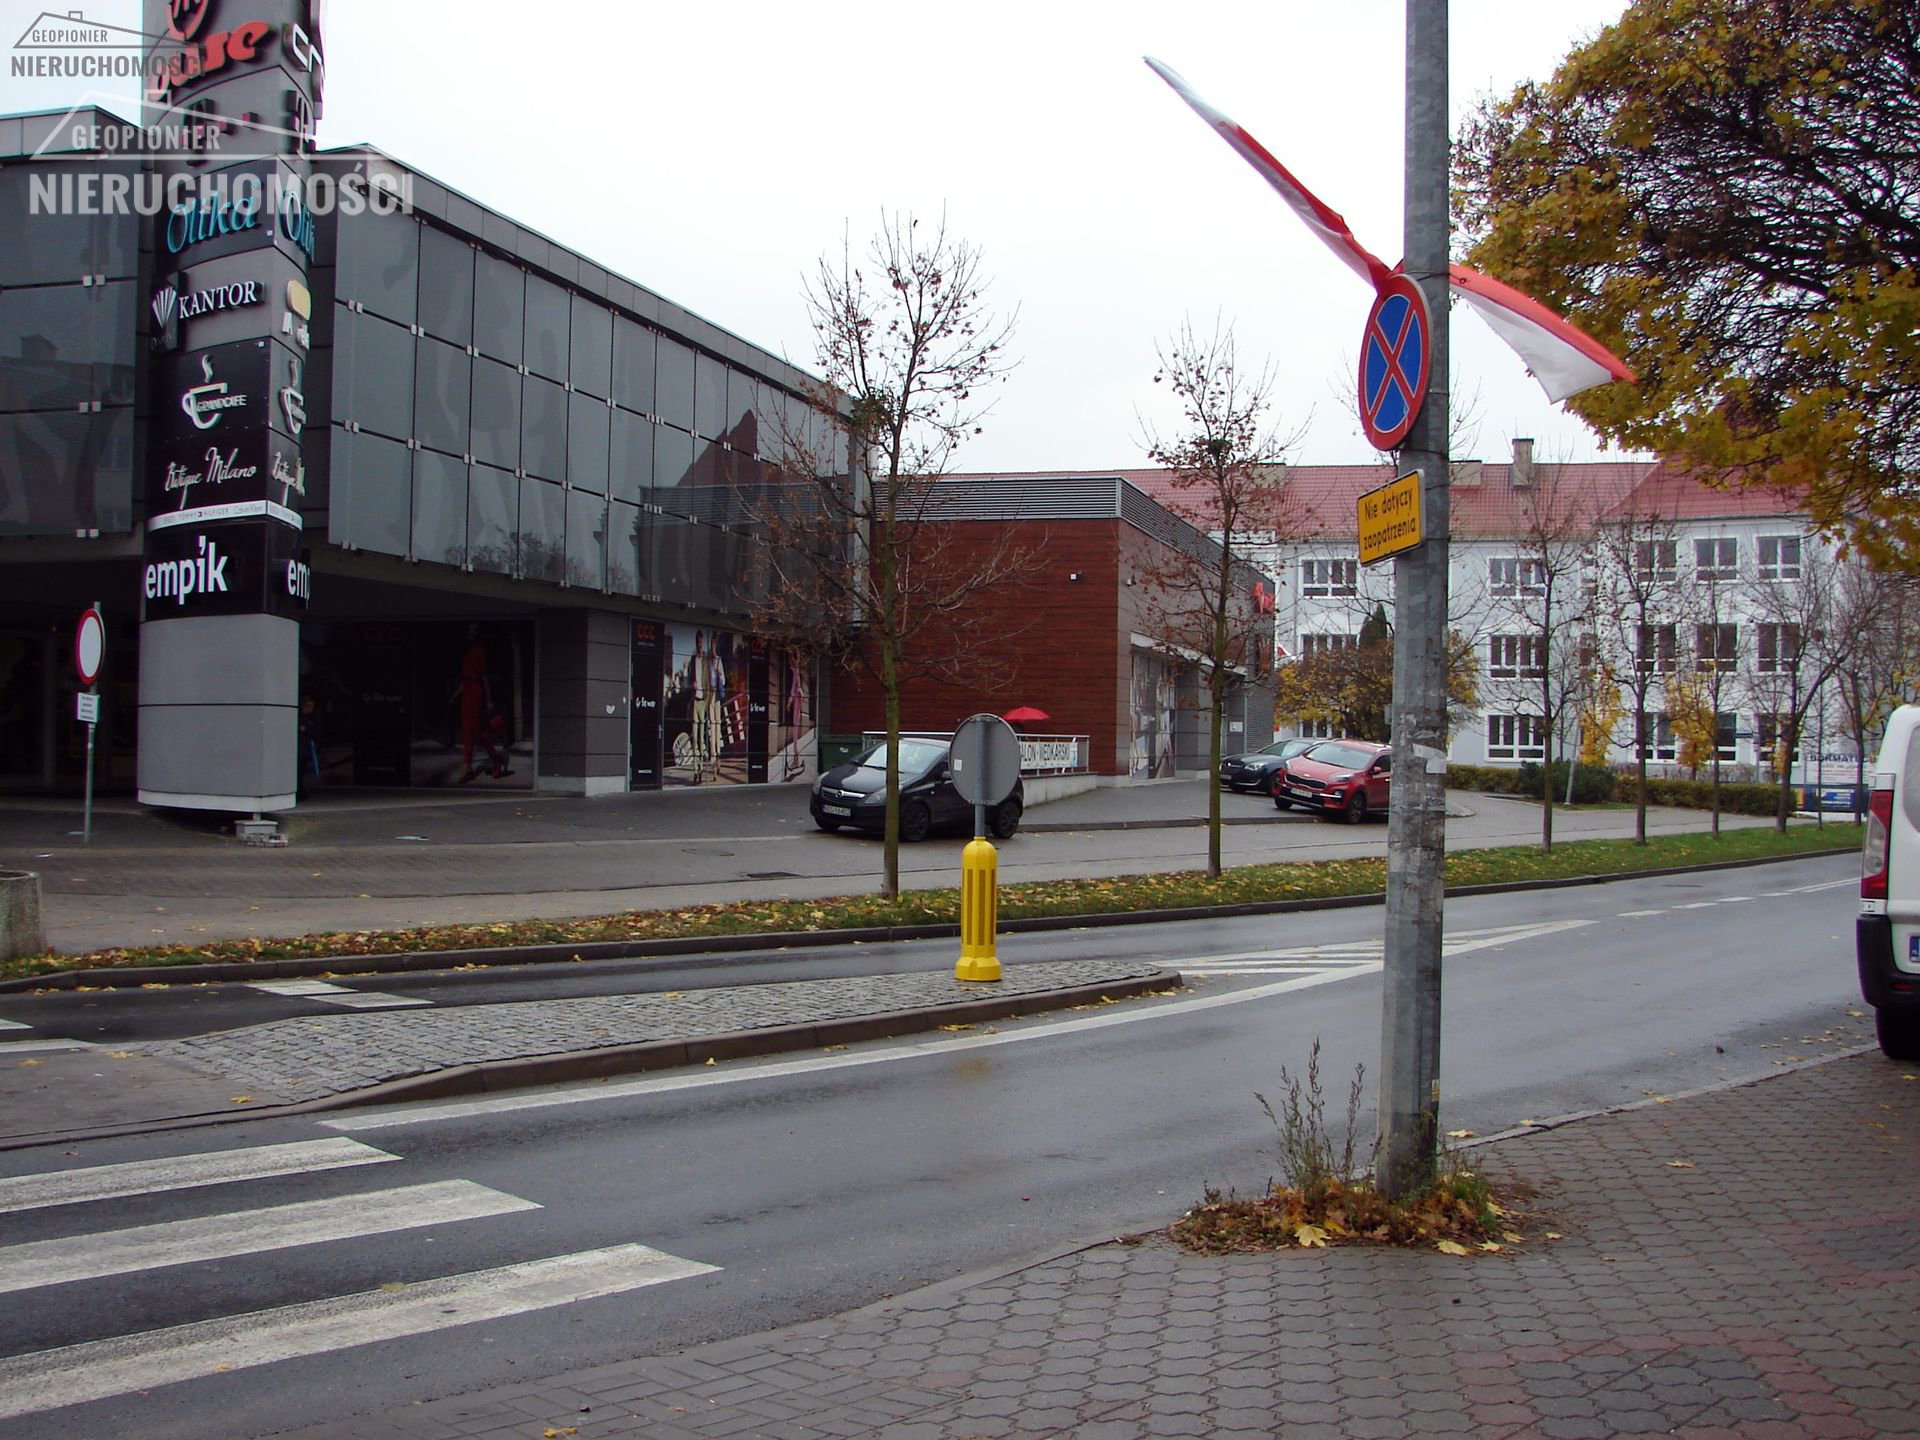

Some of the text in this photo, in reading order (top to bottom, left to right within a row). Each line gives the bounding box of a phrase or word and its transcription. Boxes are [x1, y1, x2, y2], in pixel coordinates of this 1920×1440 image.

[166, 188, 257, 254] Olika
[179, 280, 258, 319] KANTOR
[205, 447, 257, 483] Milano
[1364, 488, 1413, 521] Nie dotyczy
[1363, 512, 1416, 552] zaopatrzenia
[145, 535, 228, 605] empik
